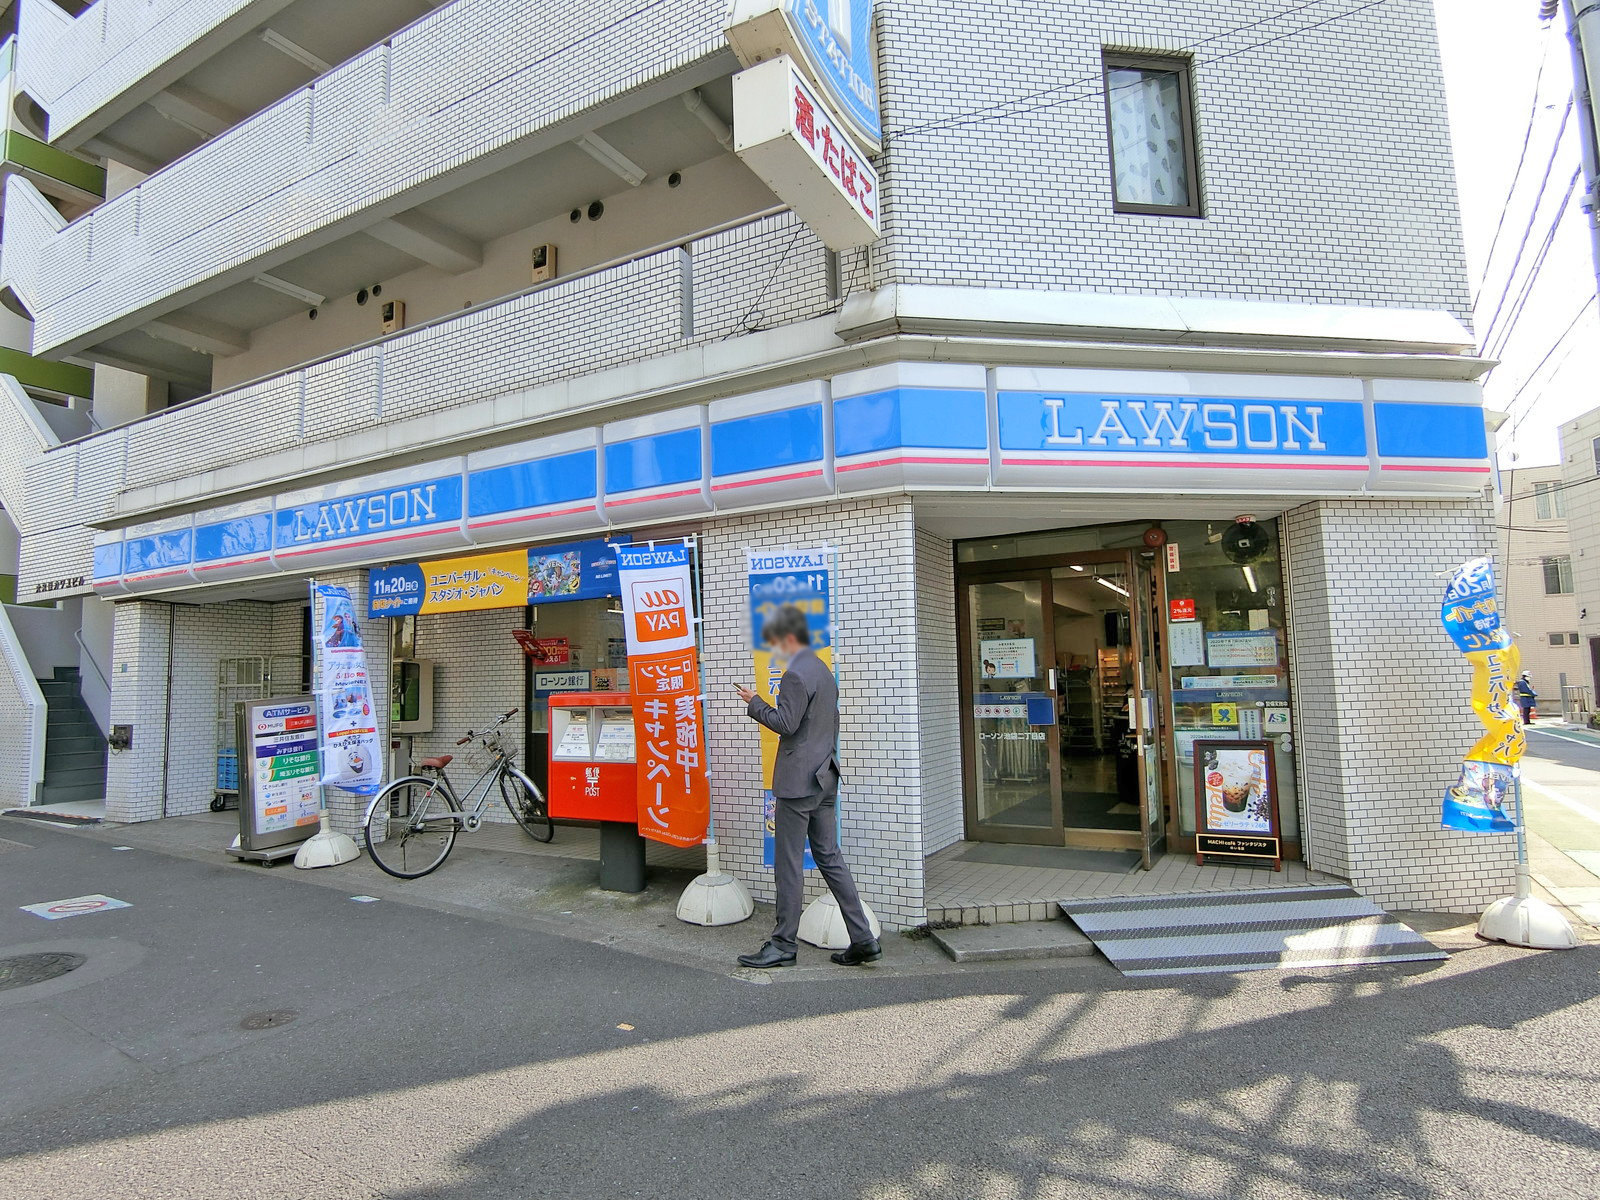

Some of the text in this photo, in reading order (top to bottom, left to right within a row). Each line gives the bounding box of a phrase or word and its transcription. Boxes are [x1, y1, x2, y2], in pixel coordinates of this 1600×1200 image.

[795, 85, 874, 220] 酒・たばこ
[1043, 398, 1328, 451] LAWSON
[294, 485, 437, 542] LAWSON
[429, 582, 505, 603] スタジオ・ジャパン
[540, 675, 584, 687] ローソン銀行
[266, 706, 309, 718] ATMサービス
[276, 745, 304, 755] みずほ銀行
[283, 754, 311, 765] りそな銀行
[280, 765, 315, 777] 埼玉りそな銀行
[585, 766, 600, 779] 郵便
[585, 786, 600, 797] POST
